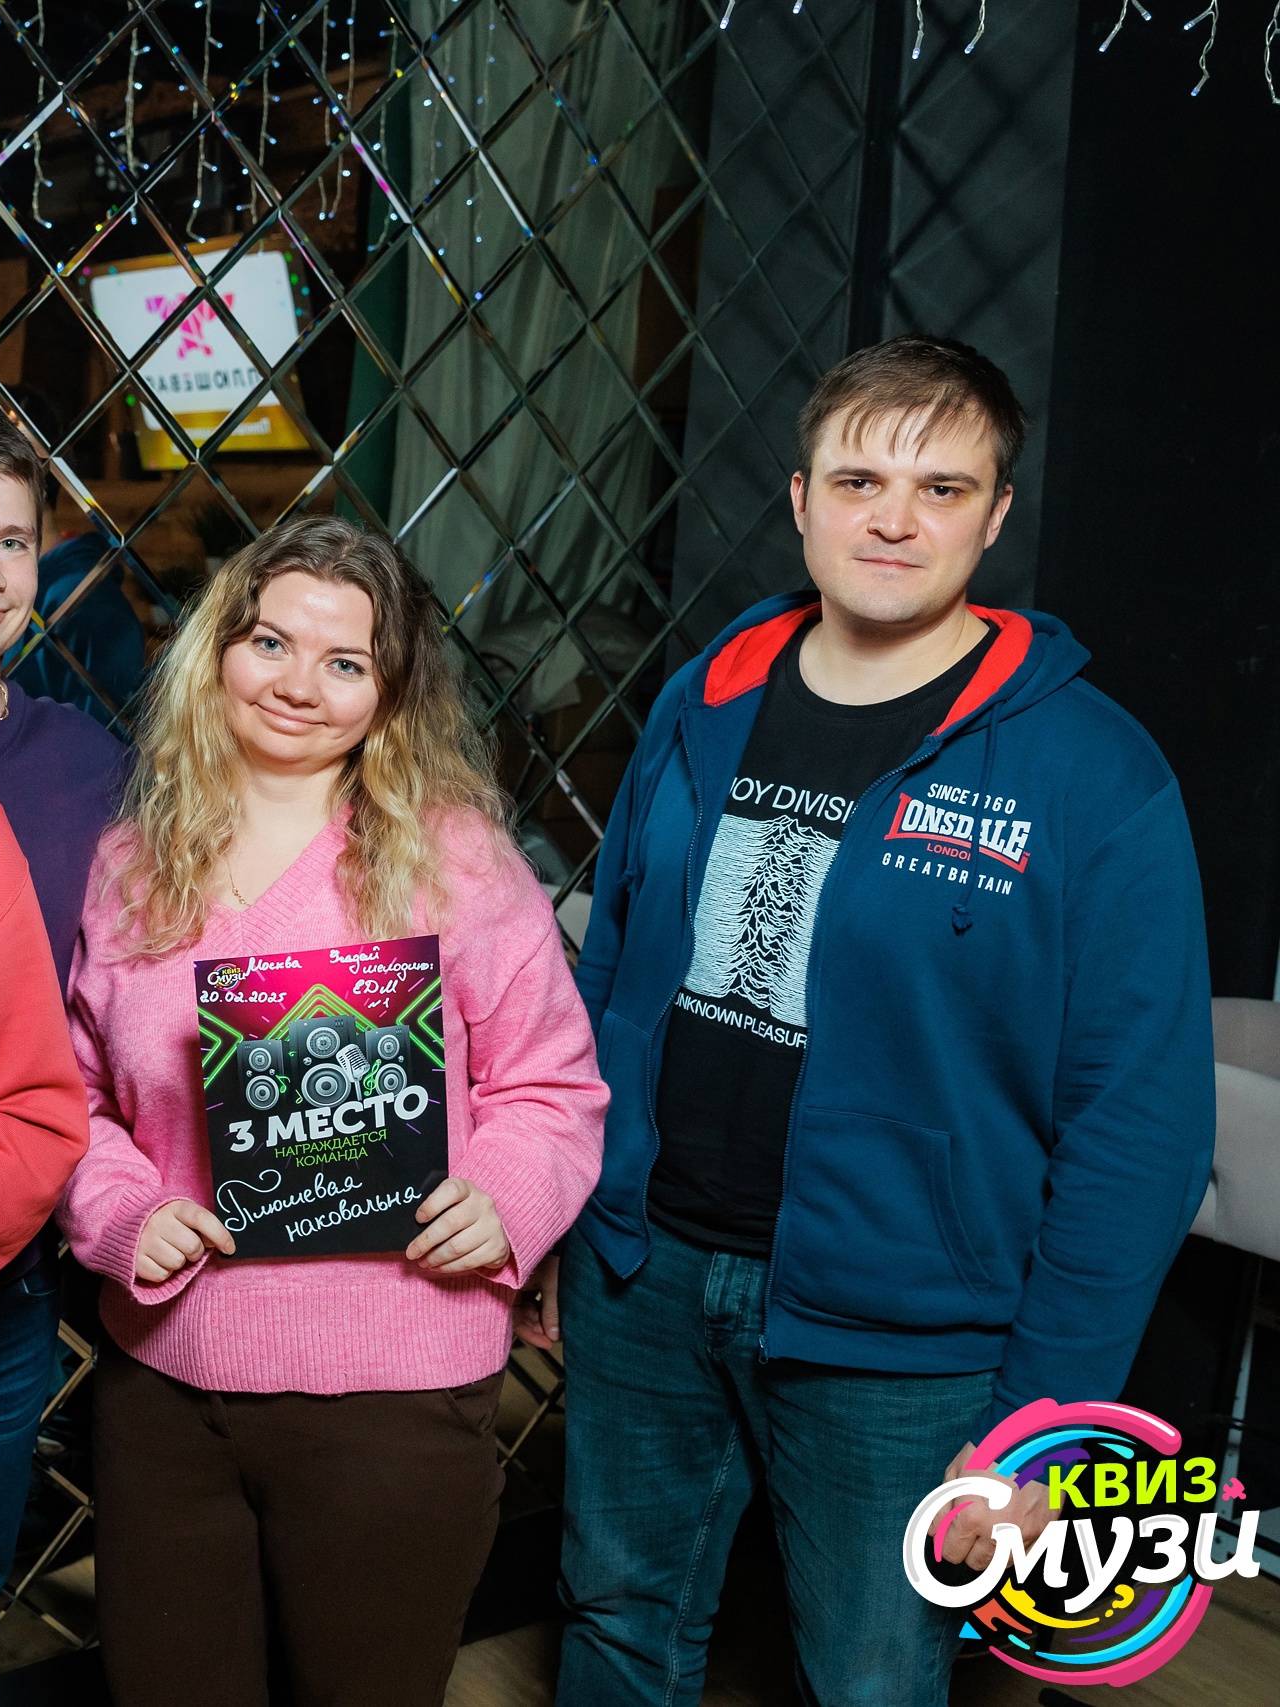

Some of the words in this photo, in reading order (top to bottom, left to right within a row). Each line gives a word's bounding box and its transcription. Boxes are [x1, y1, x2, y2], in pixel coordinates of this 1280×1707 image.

[927, 783, 970, 804] SINCE
[884, 792, 1031, 873] LONSDALE
[926, 842, 971, 861] LONDO
[882, 852, 945, 878] GREAT
[948, 867, 1012, 895] BRTAIN
[246, 956, 302, 977] Москва
[200, 990, 287, 1003] 20.02.2025
[229, 1119, 255, 1152] 3
[266, 1085, 429, 1147] МЕСТО
[274, 1129, 387, 1158] НАГРАЖДАЕТСЯ
[295, 1146, 368, 1168] КОМАНДА
[217, 1169, 362, 1232] Плюшевая
[285, 1186, 422, 1242] наковальня
